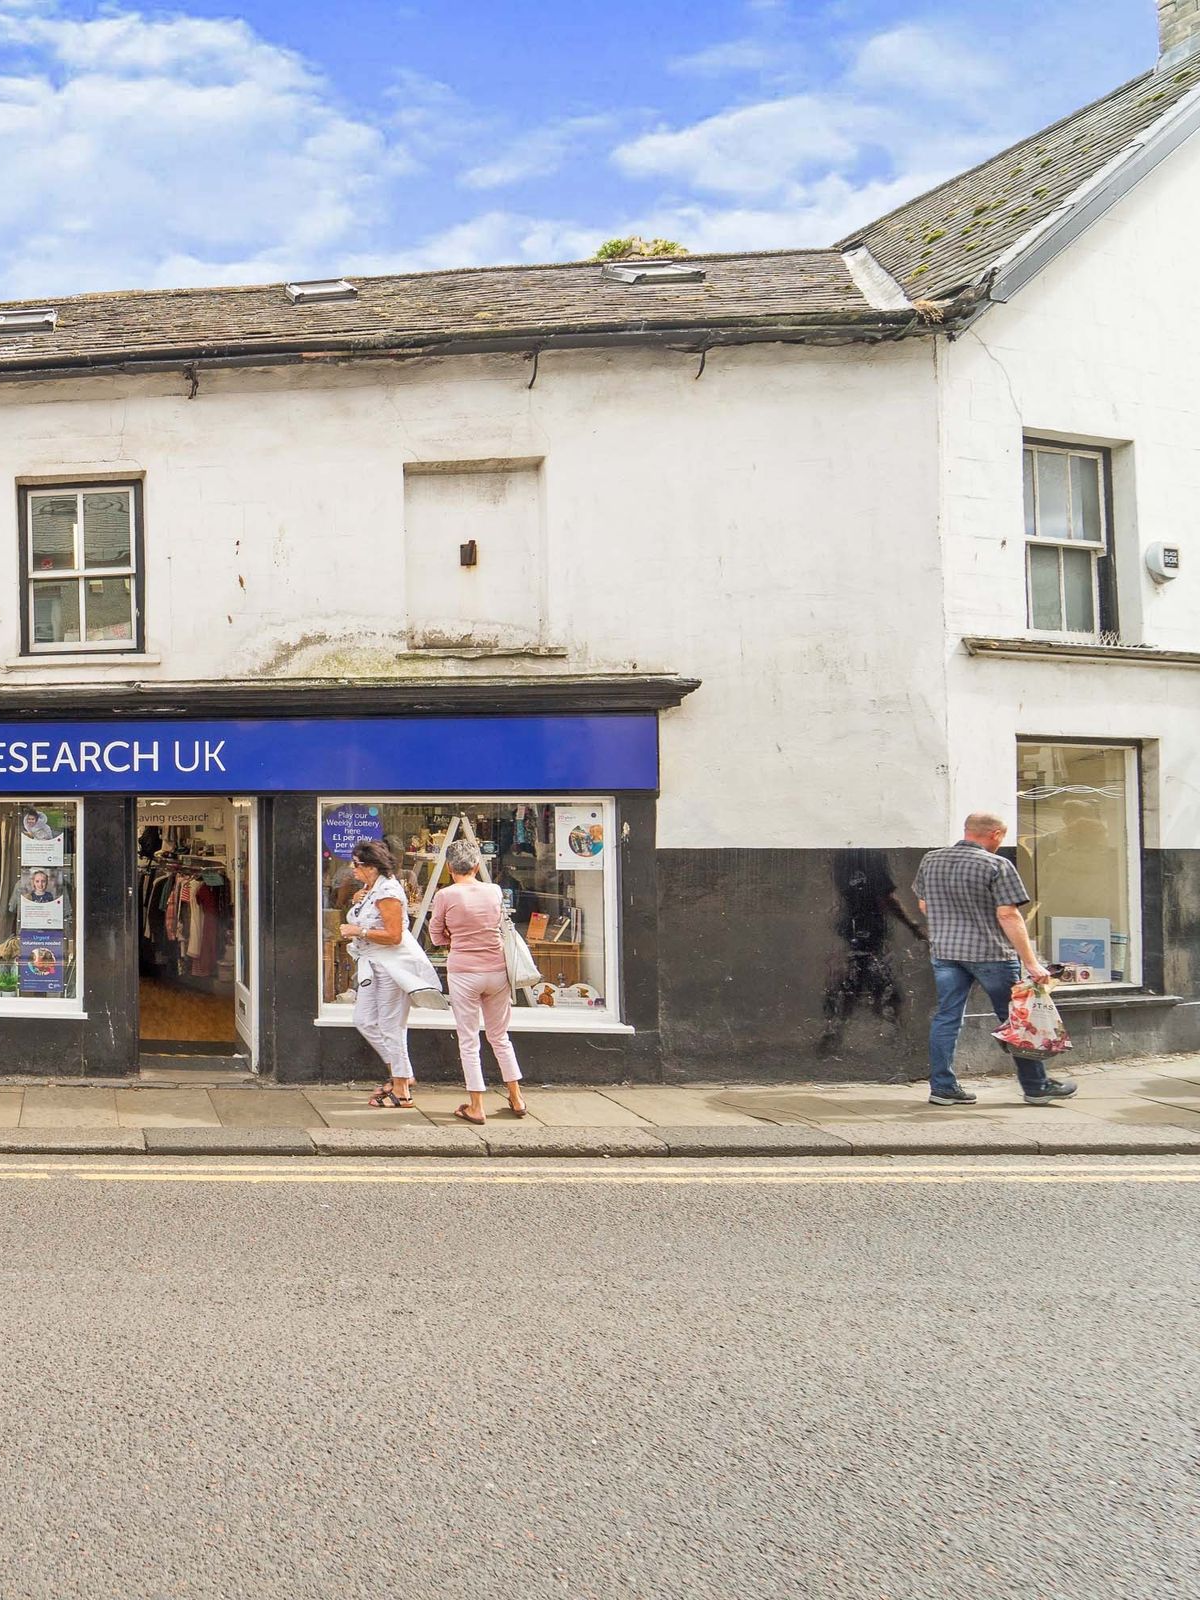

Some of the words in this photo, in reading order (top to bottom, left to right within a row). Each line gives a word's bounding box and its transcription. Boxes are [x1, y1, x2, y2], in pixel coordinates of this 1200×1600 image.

[174, 740, 226, 772] UK
[338, 811, 353, 819] Play
[326, 819, 352, 827] Weekly
[354, 820, 379, 828] Lottery
[344, 827, 361, 835] here
[332, 833, 341, 841] £1
[356, 834, 373, 843] play
